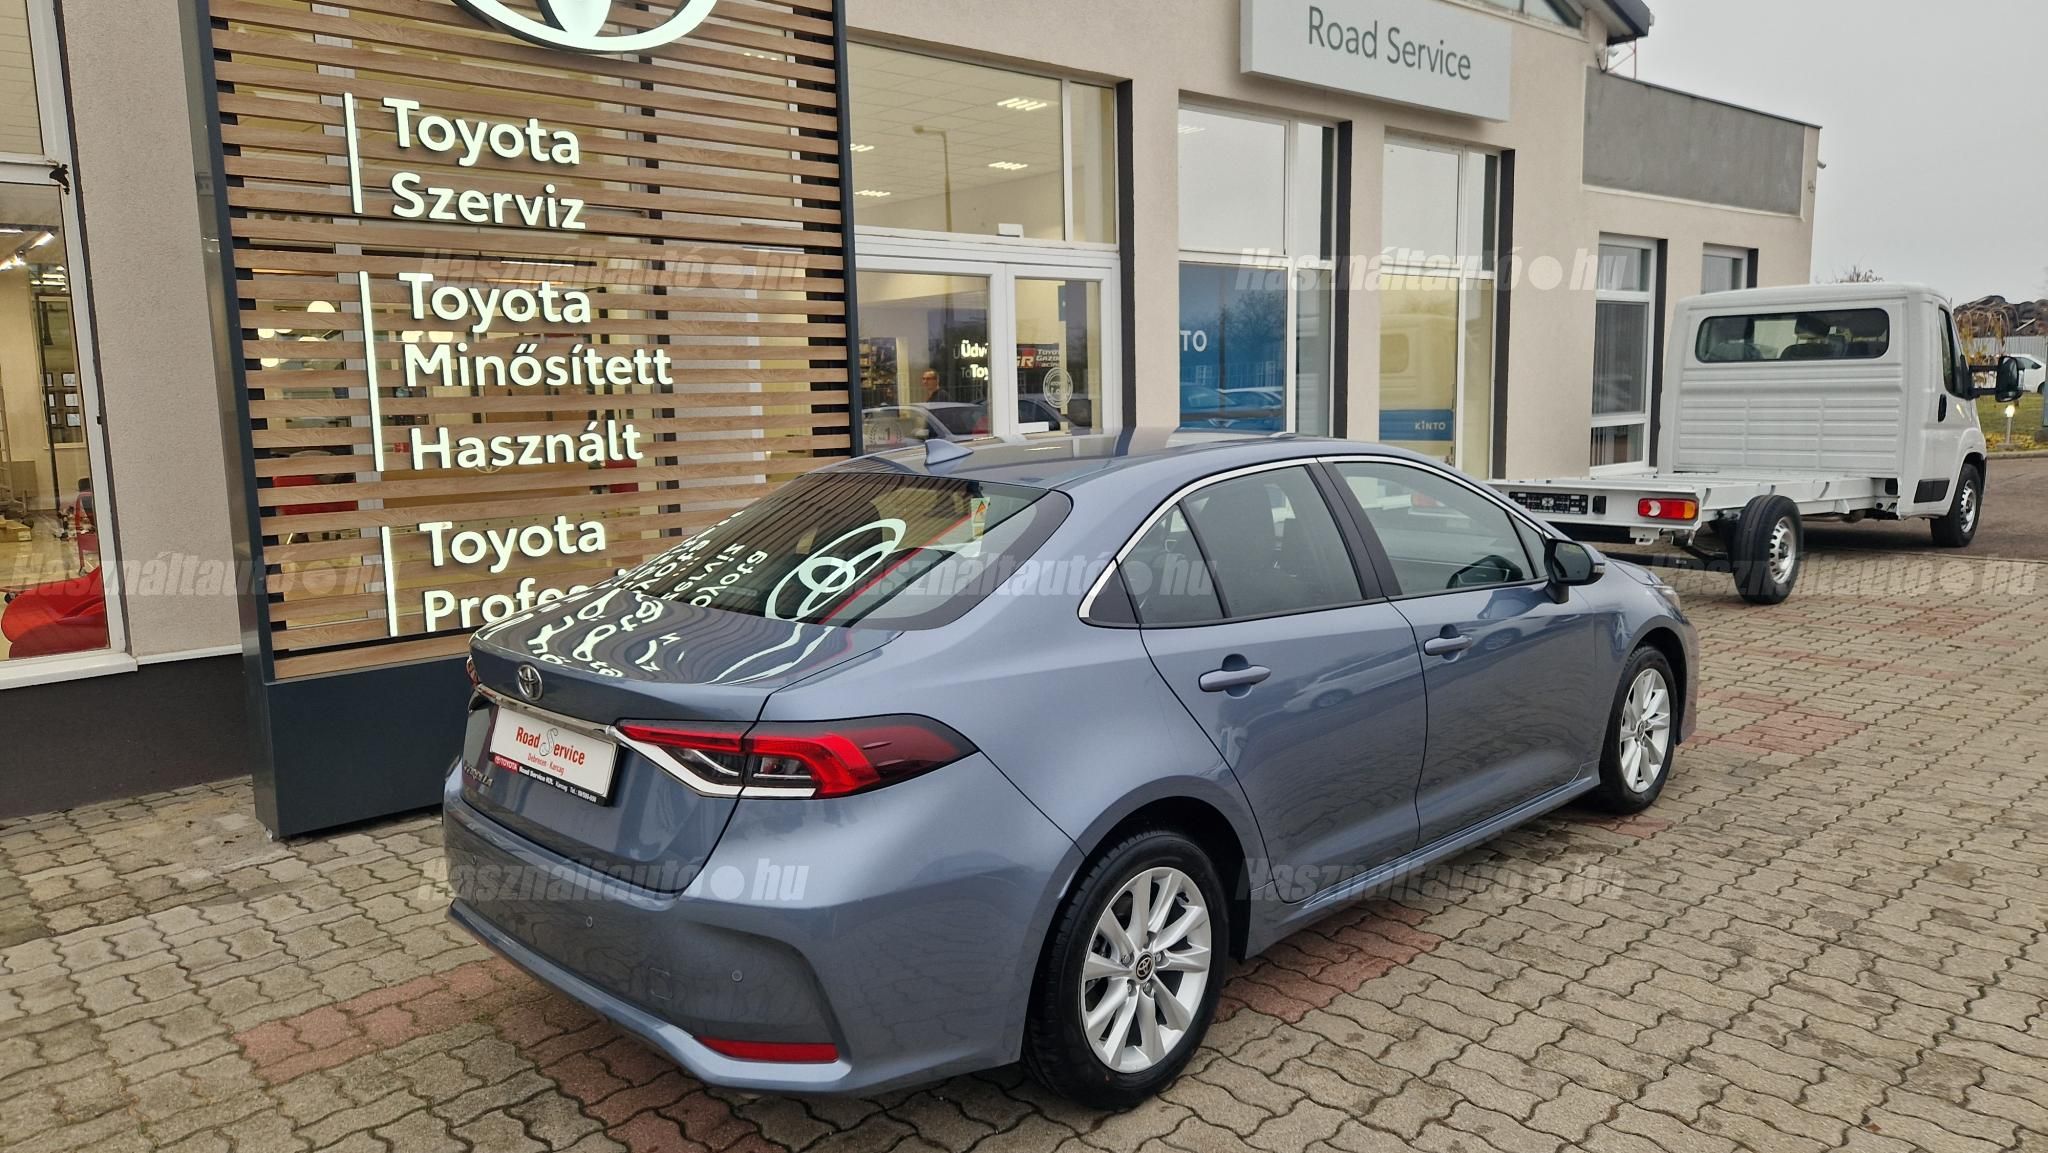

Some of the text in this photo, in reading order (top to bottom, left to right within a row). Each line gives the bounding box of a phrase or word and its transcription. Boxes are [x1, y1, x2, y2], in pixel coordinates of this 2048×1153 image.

[1308, 5, 1471, 81] Road Service
[382, 96, 580, 167] Toyota
[391, 172, 586, 229] Szerviz
[398, 272, 591, 333] Toyota
[404, 342, 673, 387] Minősített
[411, 420, 643, 470] Használt
[418, 515, 606, 573] Toyota
[515, 726, 586, 767] Road Service
